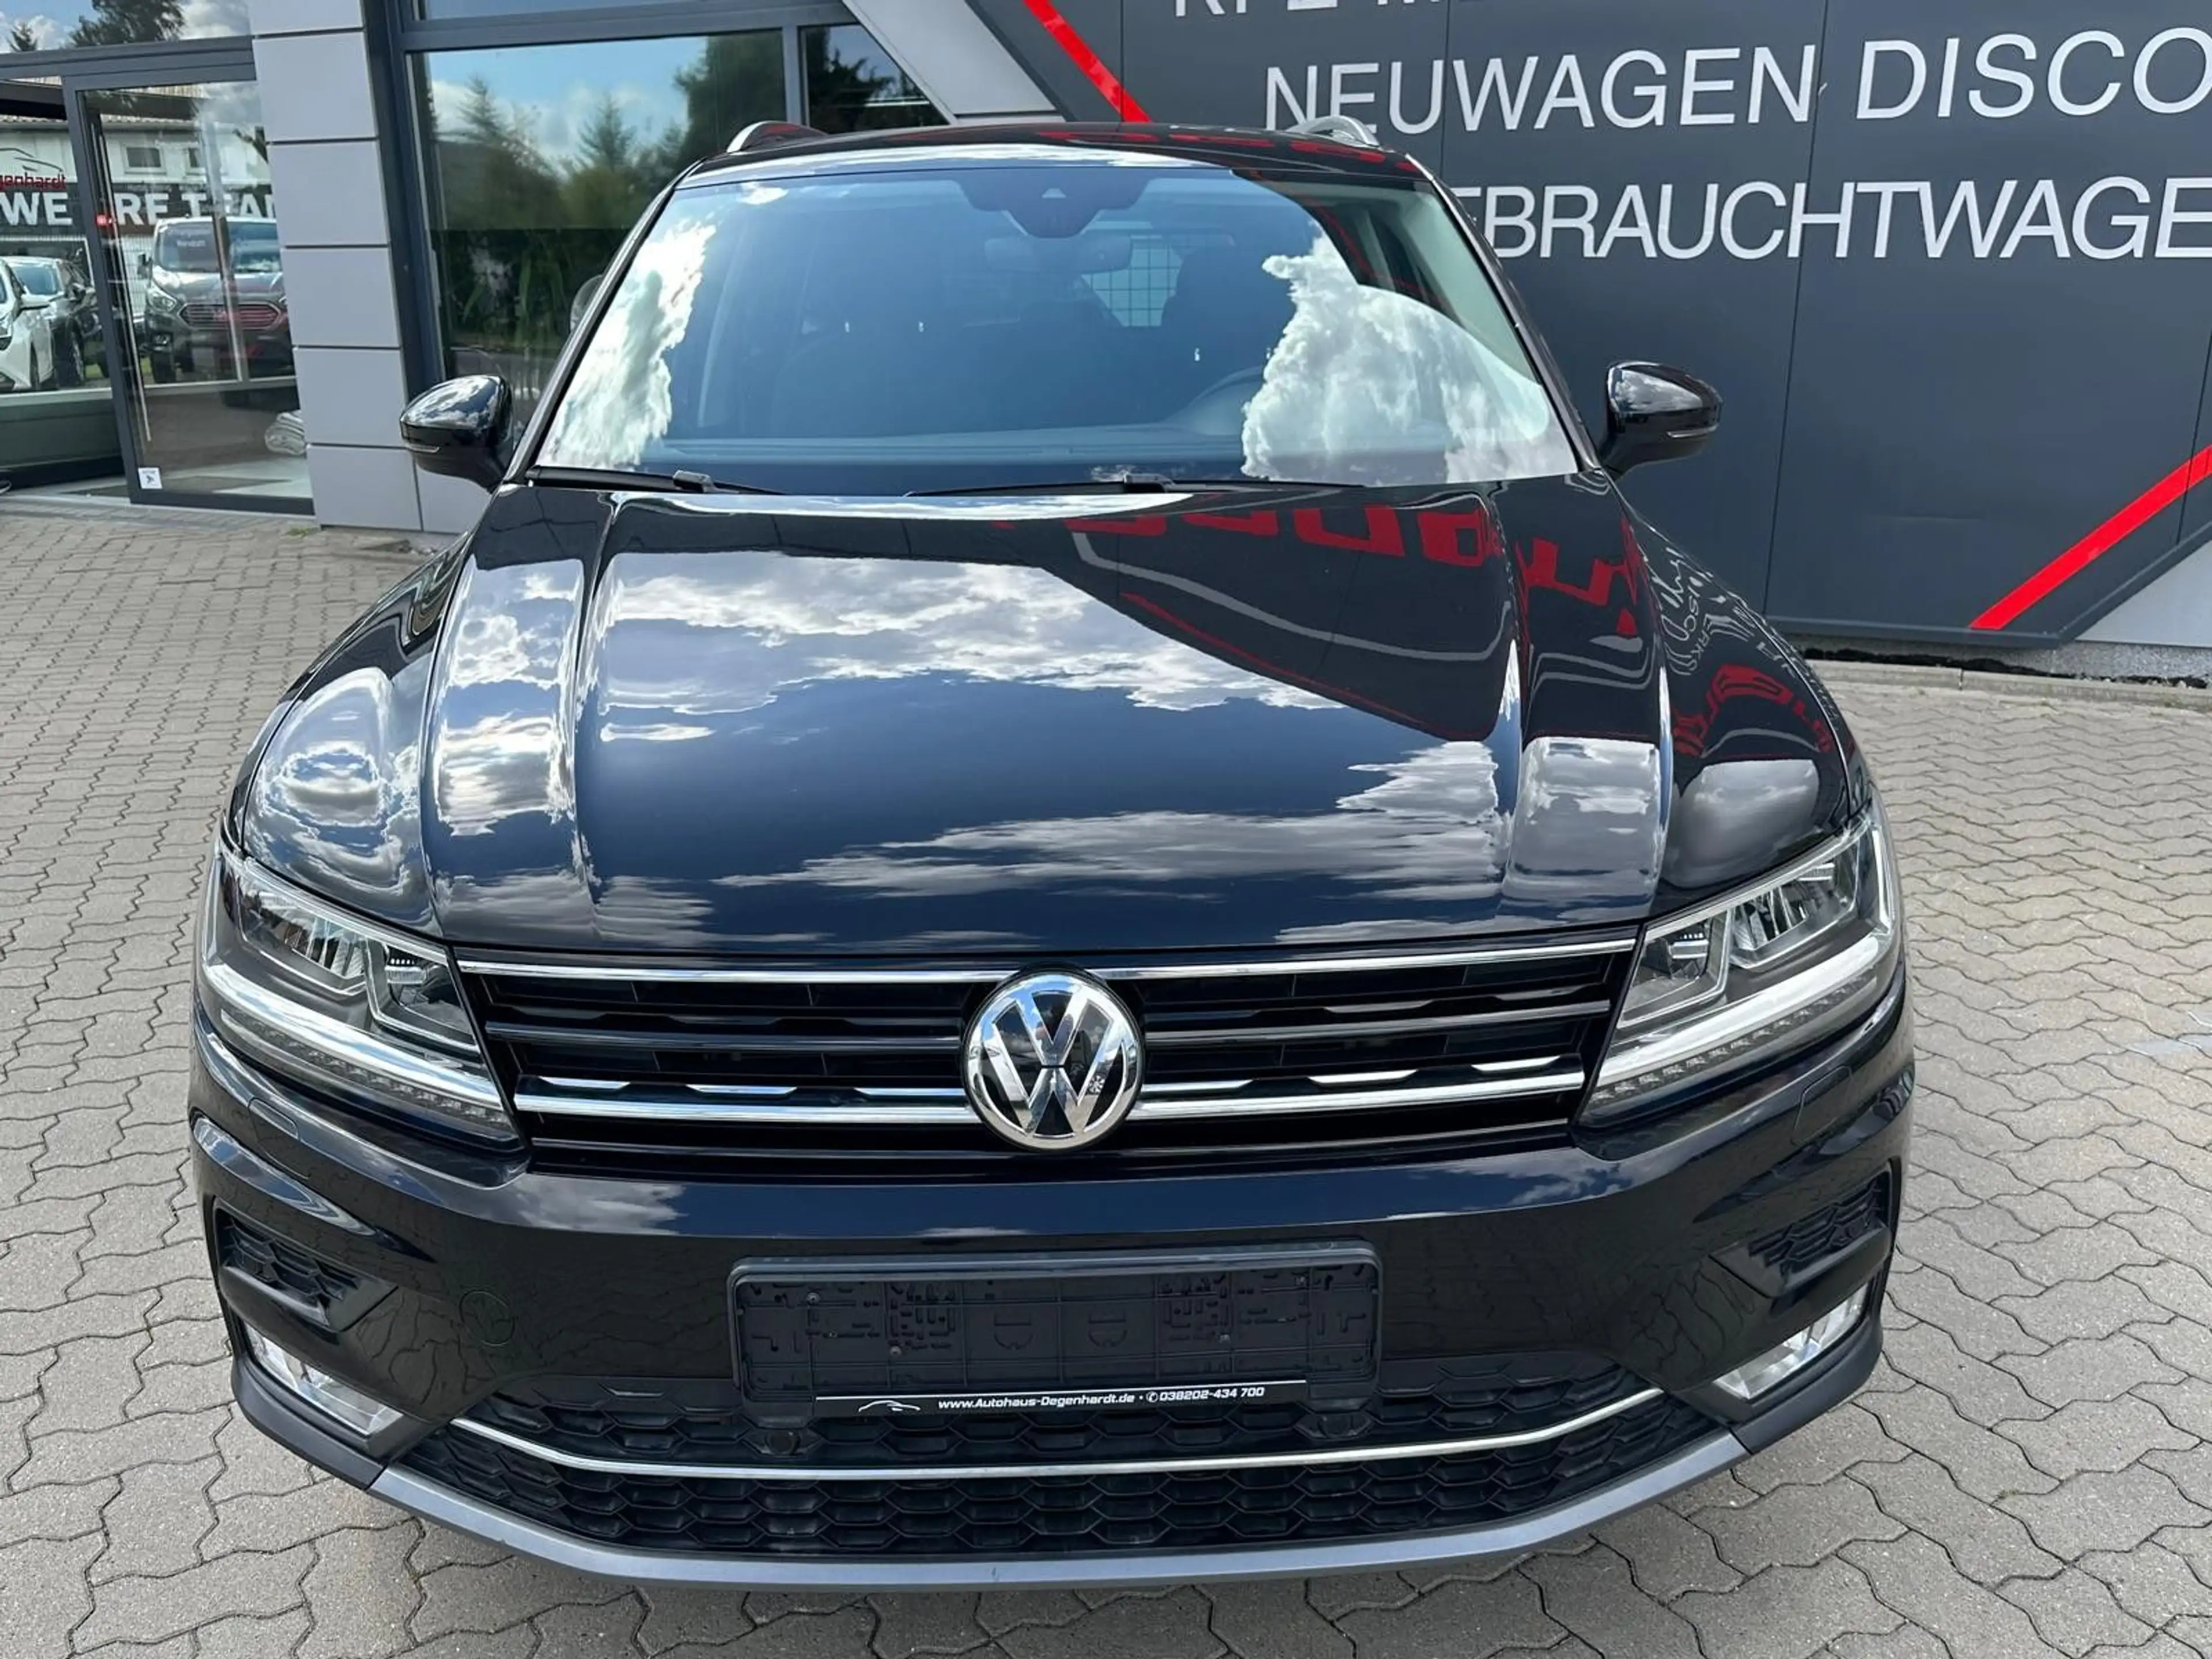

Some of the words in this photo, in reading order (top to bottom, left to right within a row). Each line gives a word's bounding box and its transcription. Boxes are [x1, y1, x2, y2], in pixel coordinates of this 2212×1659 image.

[1266, 44, 1816, 135] NEUWAGEN
[1856, 26, 2212, 119] DISCO
[0, 192, 73, 225] WE
[114, 193, 169, 225] RE
[1449, 176, 2212, 260] BRAUCHTWAGE
[974, 976, 1134, 1144] VW
[938, 1393, 1135, 1409] www.Autohaus-Degenhardt.de
[1159, 1388, 1237, 1402] 038202-434
[1240, 1387, 1265, 1398] 700
